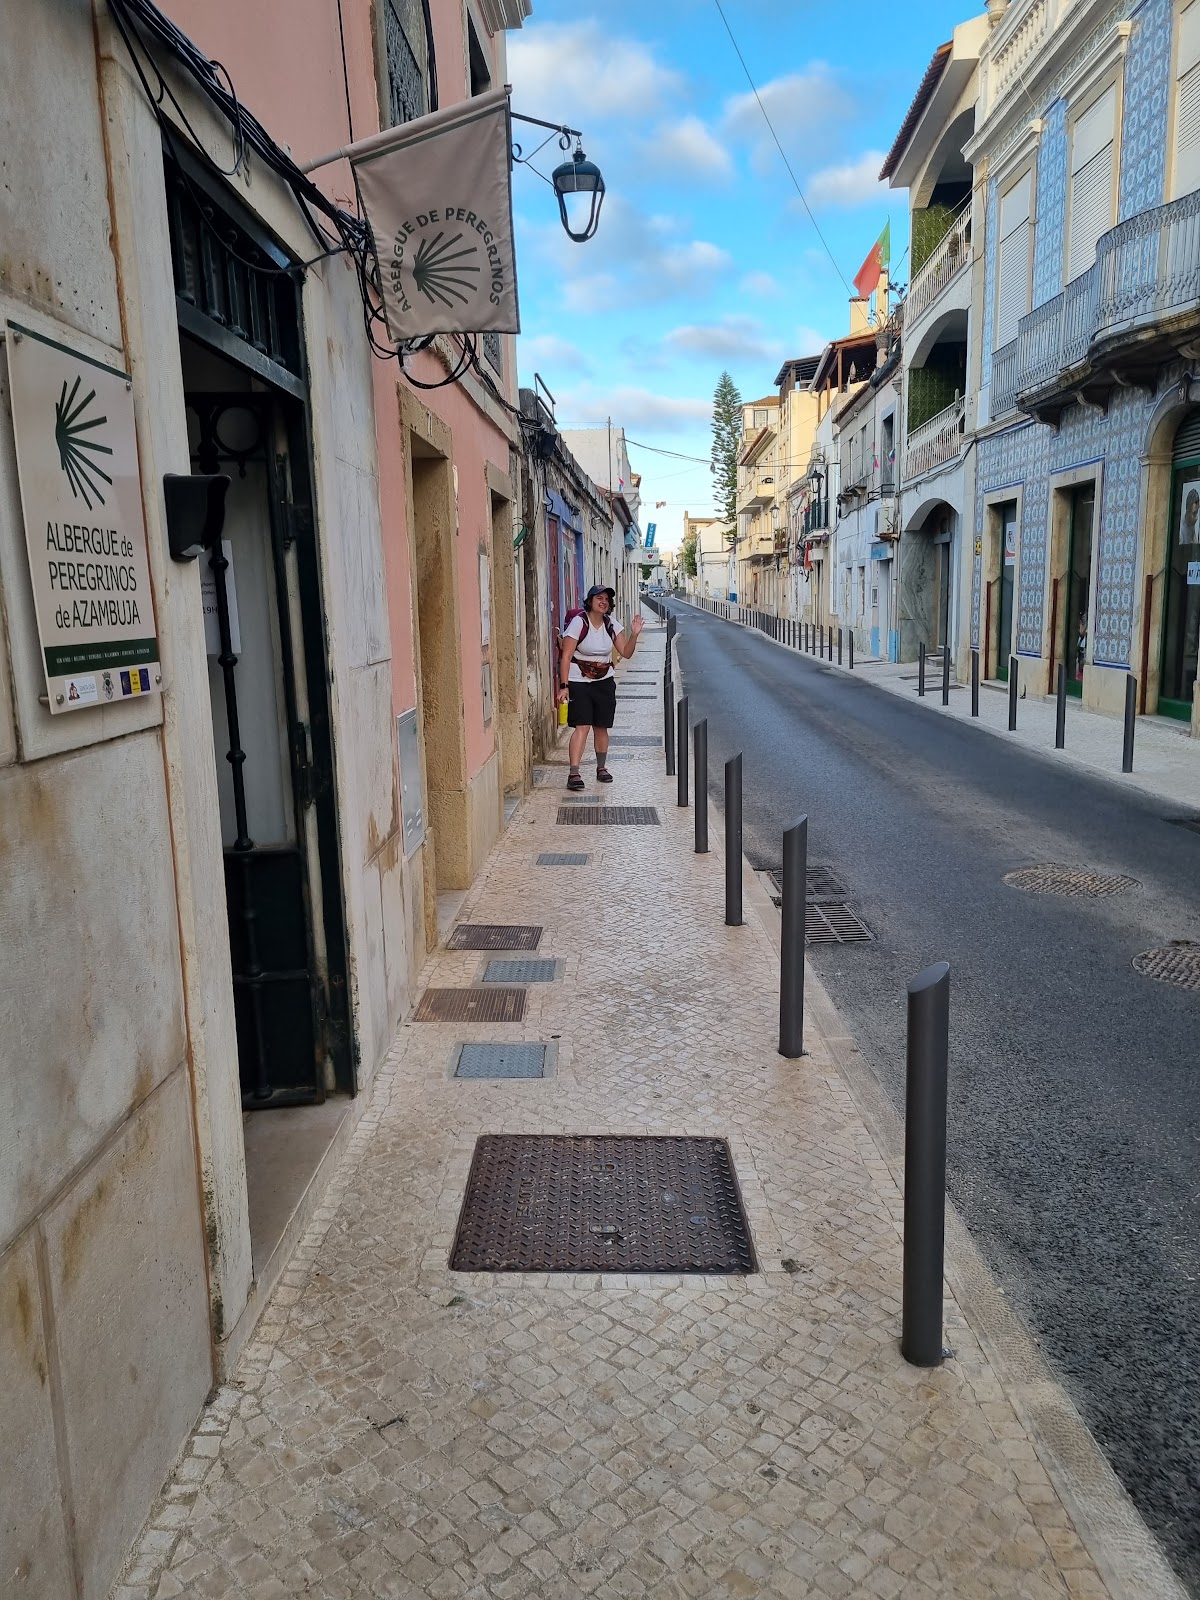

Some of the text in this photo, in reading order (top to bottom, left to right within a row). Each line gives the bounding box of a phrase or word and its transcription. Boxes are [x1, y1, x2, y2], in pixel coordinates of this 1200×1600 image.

[390, 207, 504, 313] ALBERGUE DE PEREGRINOS
[46, 521, 134, 558] ALBERGUE de
[48, 561, 138, 592] PEREGRINOS
[55, 599, 142, 630] de AZAMBUJA
